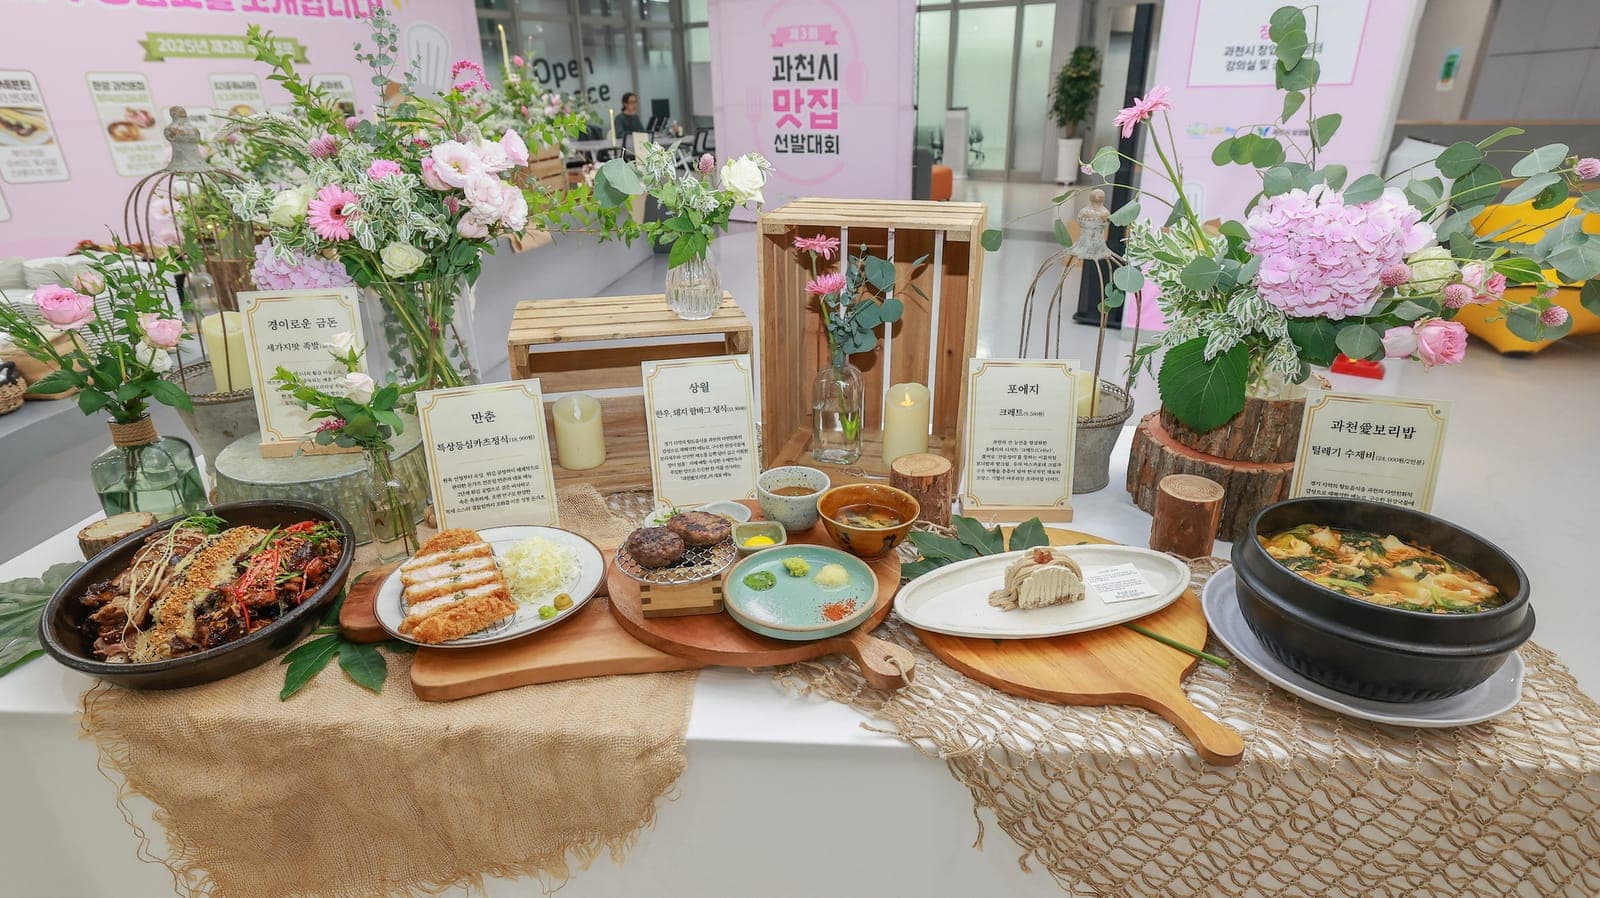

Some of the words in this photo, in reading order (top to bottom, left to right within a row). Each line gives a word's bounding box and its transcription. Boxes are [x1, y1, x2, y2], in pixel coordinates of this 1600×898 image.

[772, 53, 838, 82] 과천시
[773, 88, 838, 129] 맛집
[774, 134, 839, 155] 선발대회
[267, 318, 312, 331] 경이로운
[316, 317, 338, 328] 금돈
[689, 381, 710, 394] 상월
[1008, 384, 1039, 395] 포에지
[471, 411, 496, 424] 만춘
[1331, 420, 1417, 439] 과천愛보리밥
[1312, 445, 1341, 456] 털레기
